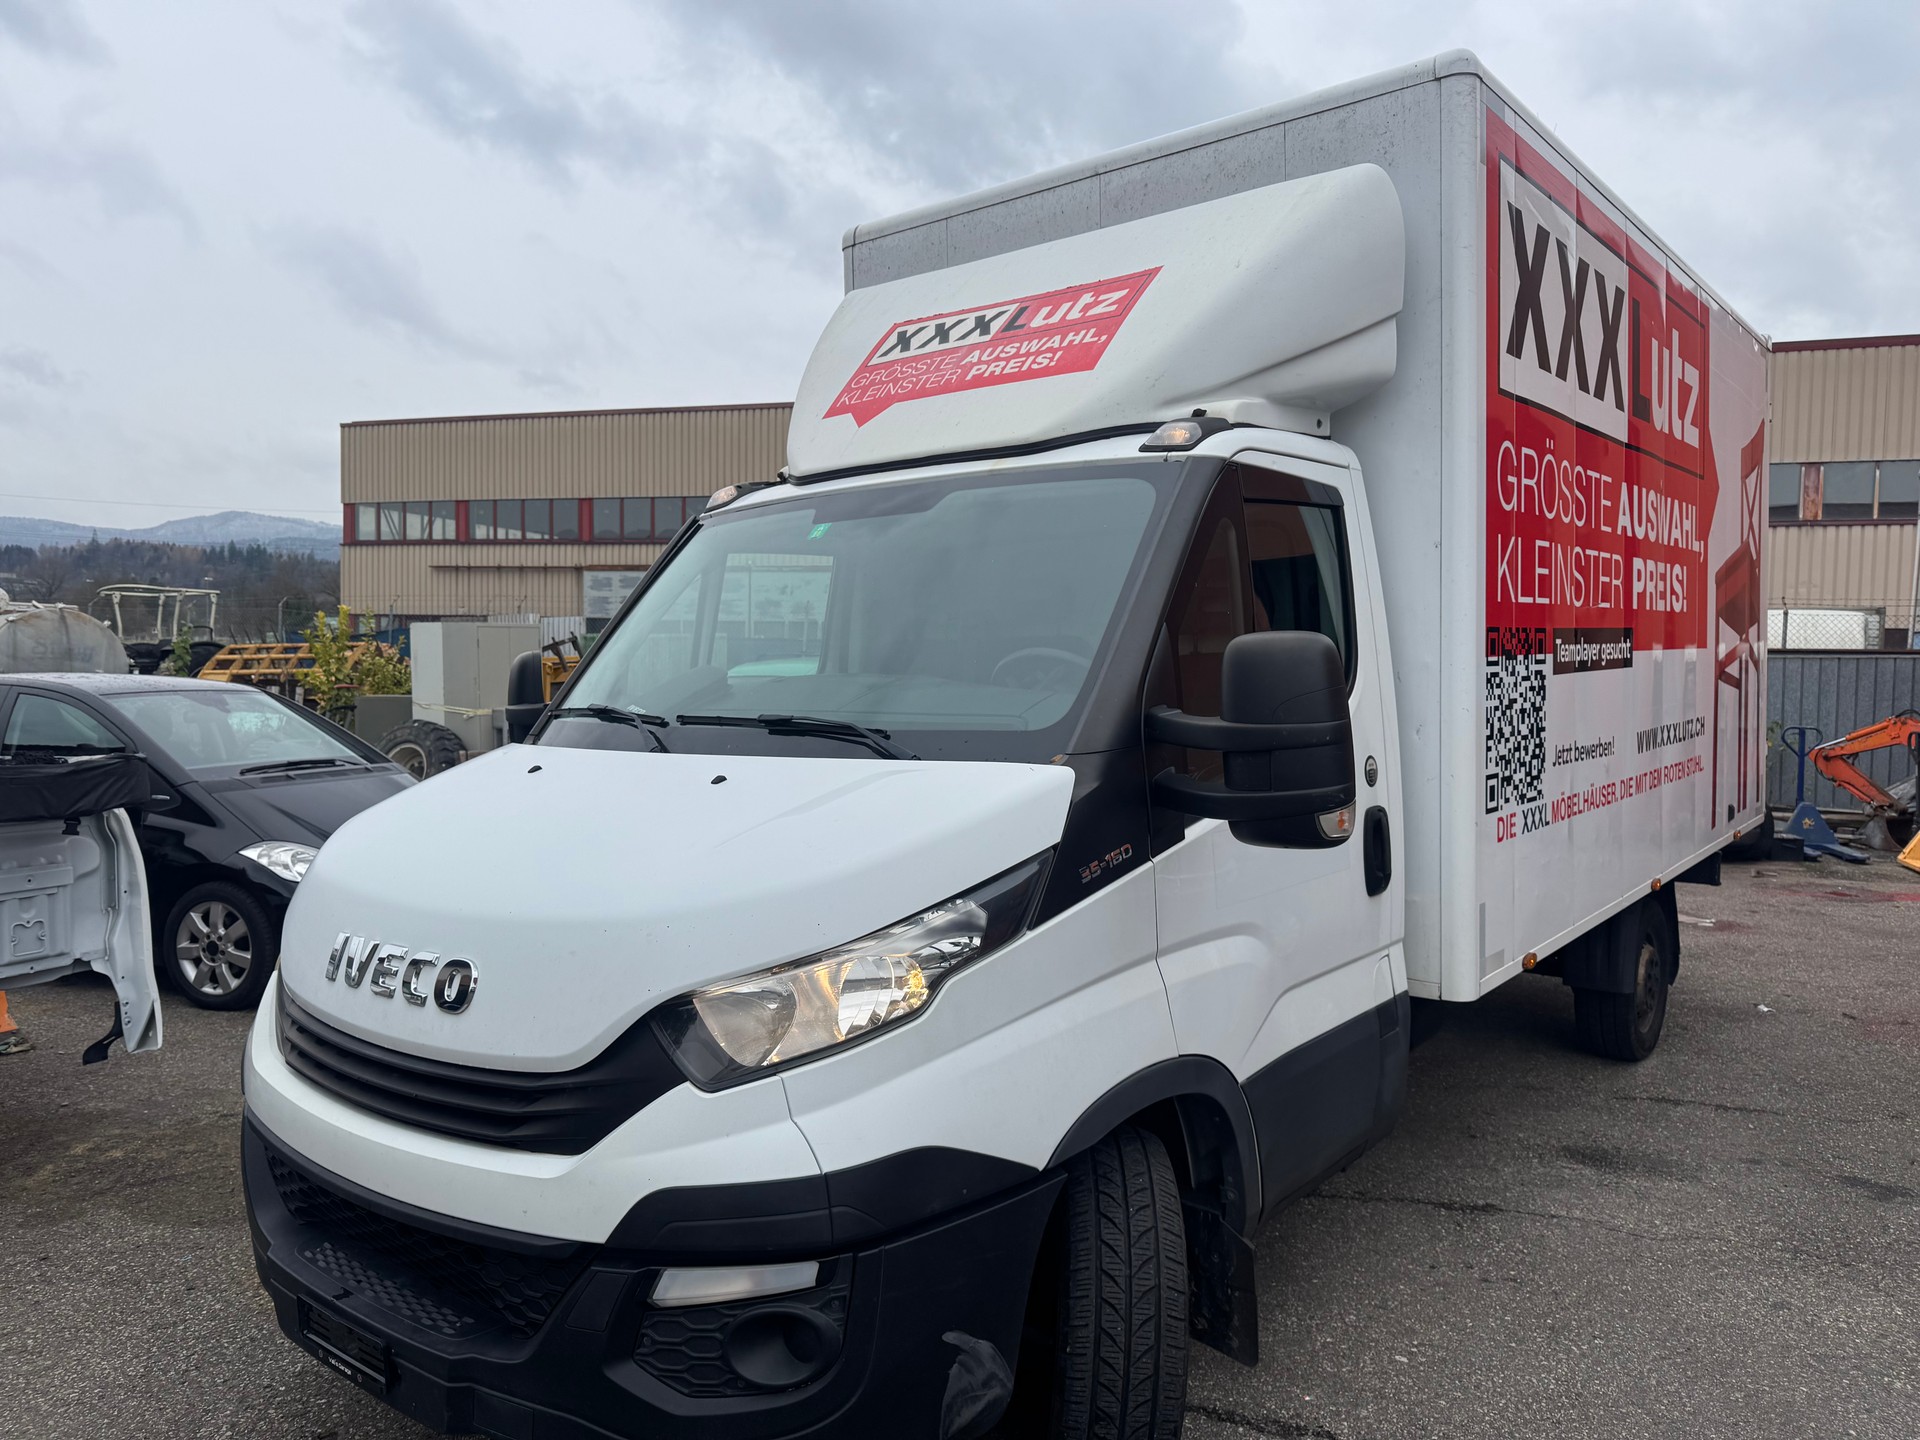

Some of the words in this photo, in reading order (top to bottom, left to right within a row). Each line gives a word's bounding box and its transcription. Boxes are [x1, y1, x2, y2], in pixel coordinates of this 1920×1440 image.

[851, 353, 961, 388] GRÖSSTE
[960, 328, 1108, 366] AUSWAHL,
[876, 288, 1130, 359] XXXLutz
[1506, 200, 1699, 449] XXXLutz
[836, 369, 962, 407] KLEINSTER
[965, 351, 1063, 381] PREIS!
[1497, 438, 1612, 533] GRÖSSTE
[1617, 482, 1704, 563] AUSWAHL,
[1497, 534, 1624, 609] KLEINSTER
[1632, 557, 1687, 613] PREIS!
[1555, 636, 1600, 668] Teamplayer
[1601, 636, 1631, 666] gesucht
[1552, 744, 1573, 767] Jetzt
[1574, 736, 1615, 763] bewerben!
[1636, 716, 1705, 754] WWW.XXXLUTZ.CH
[1497, 812, 1516, 843] DIE
[1522, 803, 1550, 835] XXXL
[1551, 781, 1618, 825] MÖBELHÄUSER.
[1620, 776, 1634, 801] DIE
[1635, 771, 1648, 796] MIT
[1649, 766, 1662, 791] DEM
[1664, 761, 1685, 785] ROTEN
[325, 931, 479, 1015] IVECO
